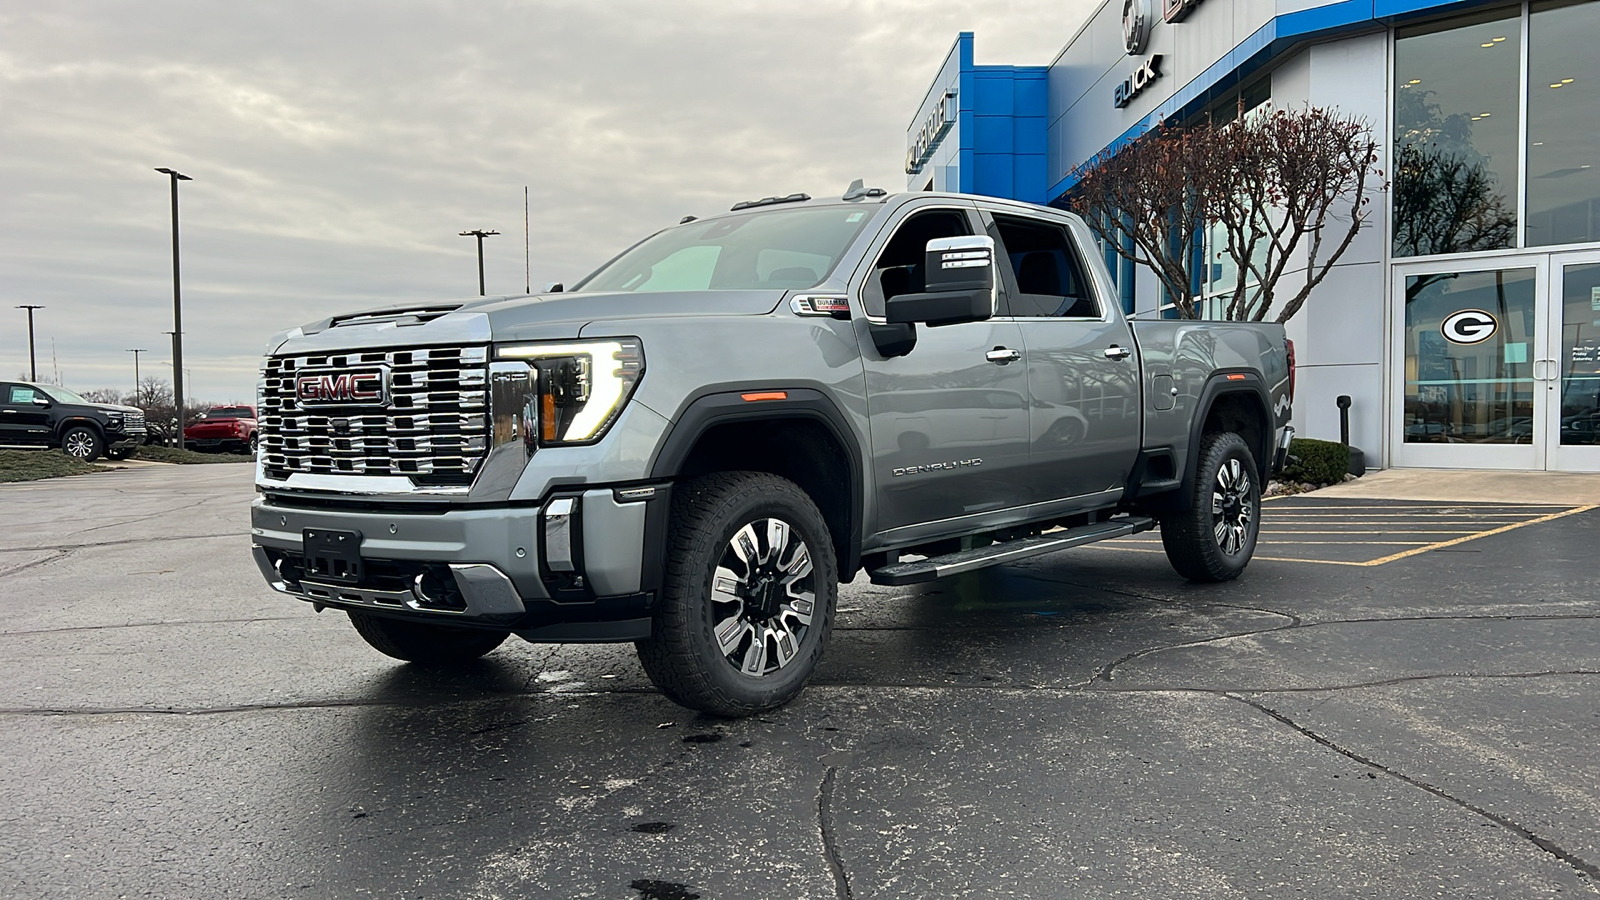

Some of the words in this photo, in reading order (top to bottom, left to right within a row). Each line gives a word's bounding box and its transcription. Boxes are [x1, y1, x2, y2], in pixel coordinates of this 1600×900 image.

[1114, 53, 1160, 108] BUICK
[1442, 310, 1496, 344] G
[297, 373, 381, 401] GMC
[892, 461, 957, 477] DENALI
[959, 457, 984, 468] HD
